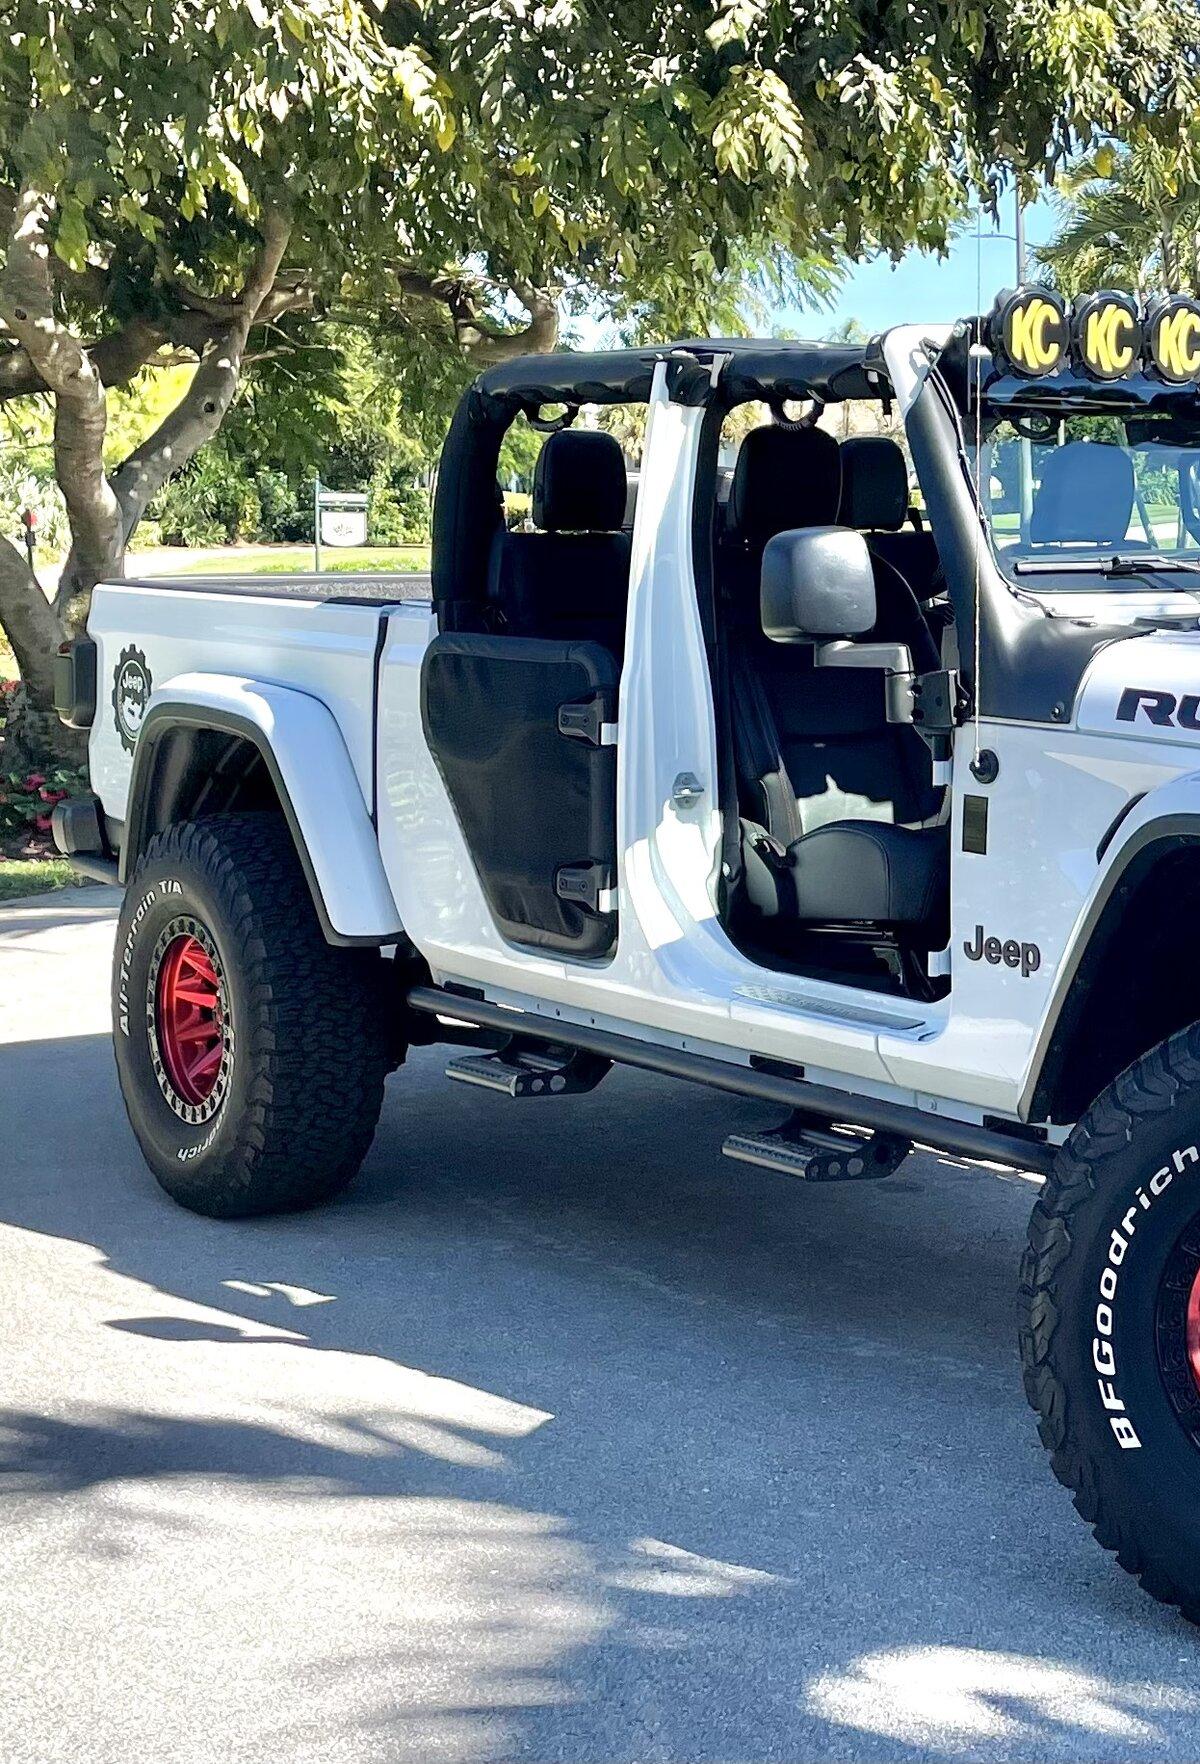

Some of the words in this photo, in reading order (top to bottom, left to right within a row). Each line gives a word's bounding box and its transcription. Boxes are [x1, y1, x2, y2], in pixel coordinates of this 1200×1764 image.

[1011, 299, 1060, 369] KC
[1086, 303, 1134, 373] KC
[122, 671, 143, 693] Jeep
[158, 879, 183, 895] T/A
[963, 925, 1042, 978] Jeep
[1093, 1146, 1199, 1448] BFGoodrich
